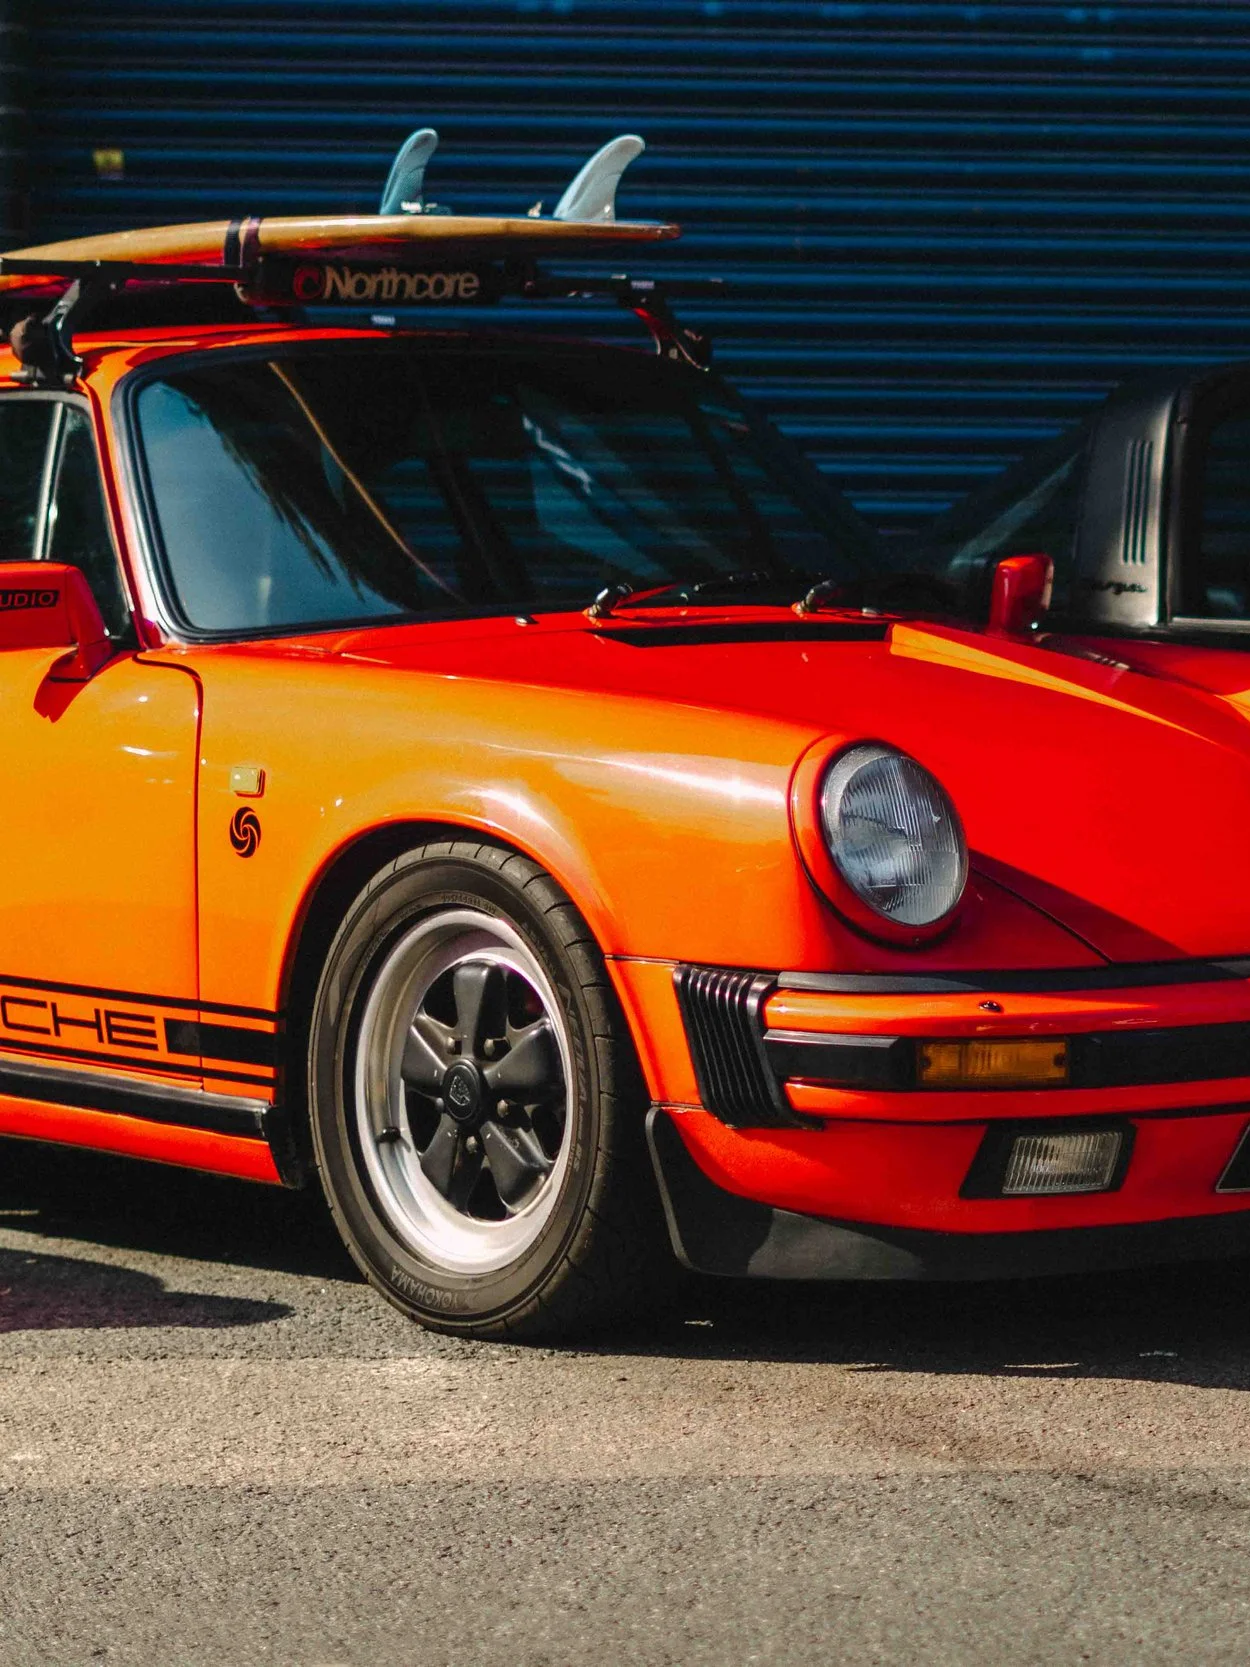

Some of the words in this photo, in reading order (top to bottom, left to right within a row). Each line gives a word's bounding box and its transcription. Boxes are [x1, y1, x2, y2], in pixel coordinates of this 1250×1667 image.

[323, 265, 480, 300] Northcore
[0, 994, 159, 1051] CHE
[391, 1264, 462, 1310] YOKOHAMA
